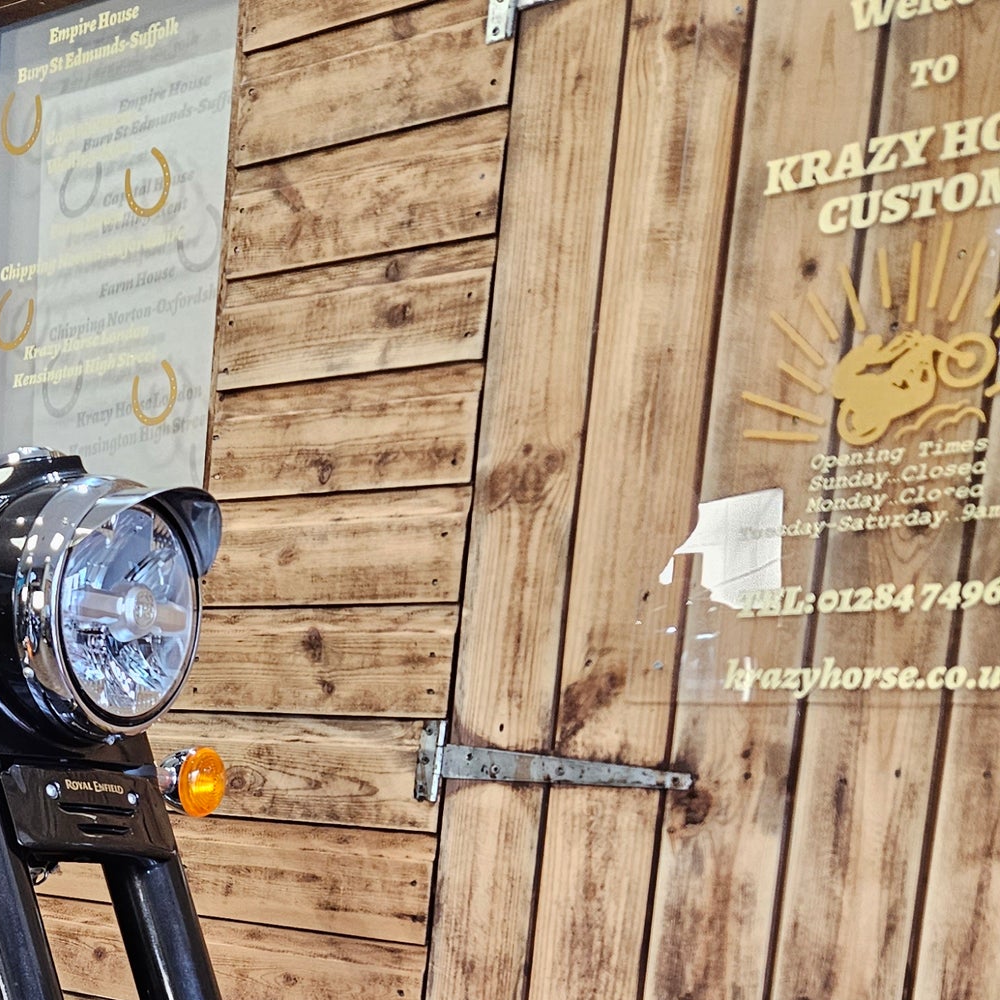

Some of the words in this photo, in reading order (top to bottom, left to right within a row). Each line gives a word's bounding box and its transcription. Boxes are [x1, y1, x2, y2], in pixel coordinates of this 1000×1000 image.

[49, 17, 97, 45] Empire
[98, 5, 140, 30] House
[17, 64, 48, 84] Bury
[49, 55, 64, 74] St
[64, 16, 179, 71] Edmunds-Suffolk
[910, 53, 960, 89] TO
[763, 125, 936, 197] KRAZY
[23, 342, 61, 362] Krazy
[11, 363, 83, 388] Kensington
[810, 447, 906, 474] Opening
[918, 437, 990, 458] Times
[64, 778, 94, 792] ROYAL
[93, 780, 124, 795] ENFIELD
